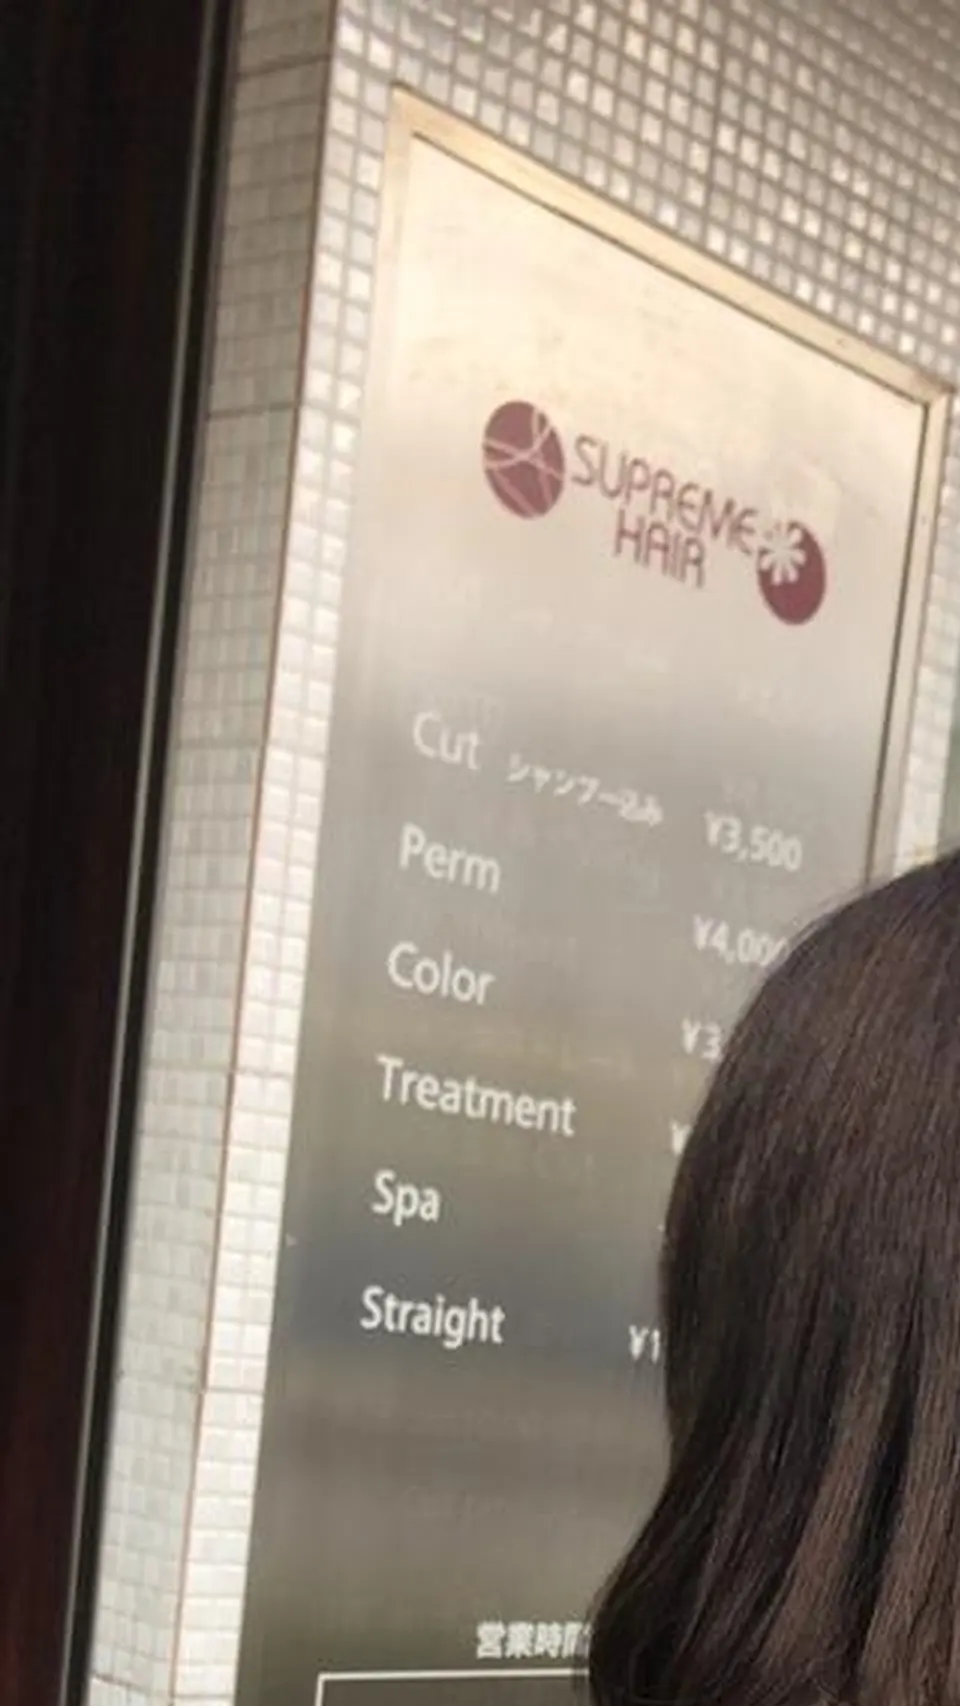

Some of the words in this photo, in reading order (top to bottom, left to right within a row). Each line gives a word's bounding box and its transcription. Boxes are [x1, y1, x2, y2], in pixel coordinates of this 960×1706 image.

[572, 434, 758, 557] SUPREME
[613, 508, 706, 590] HAIR
[412, 712, 481, 771] Cut
[705, 812, 803, 873] ¥3,500
[399, 823, 502, 894] Perm
[386, 941, 495, 1006] Color
[376, 1055, 577, 1137] Treatment
[371, 1169, 441, 1227] Spa
[360, 1286, 506, 1349] Straight
